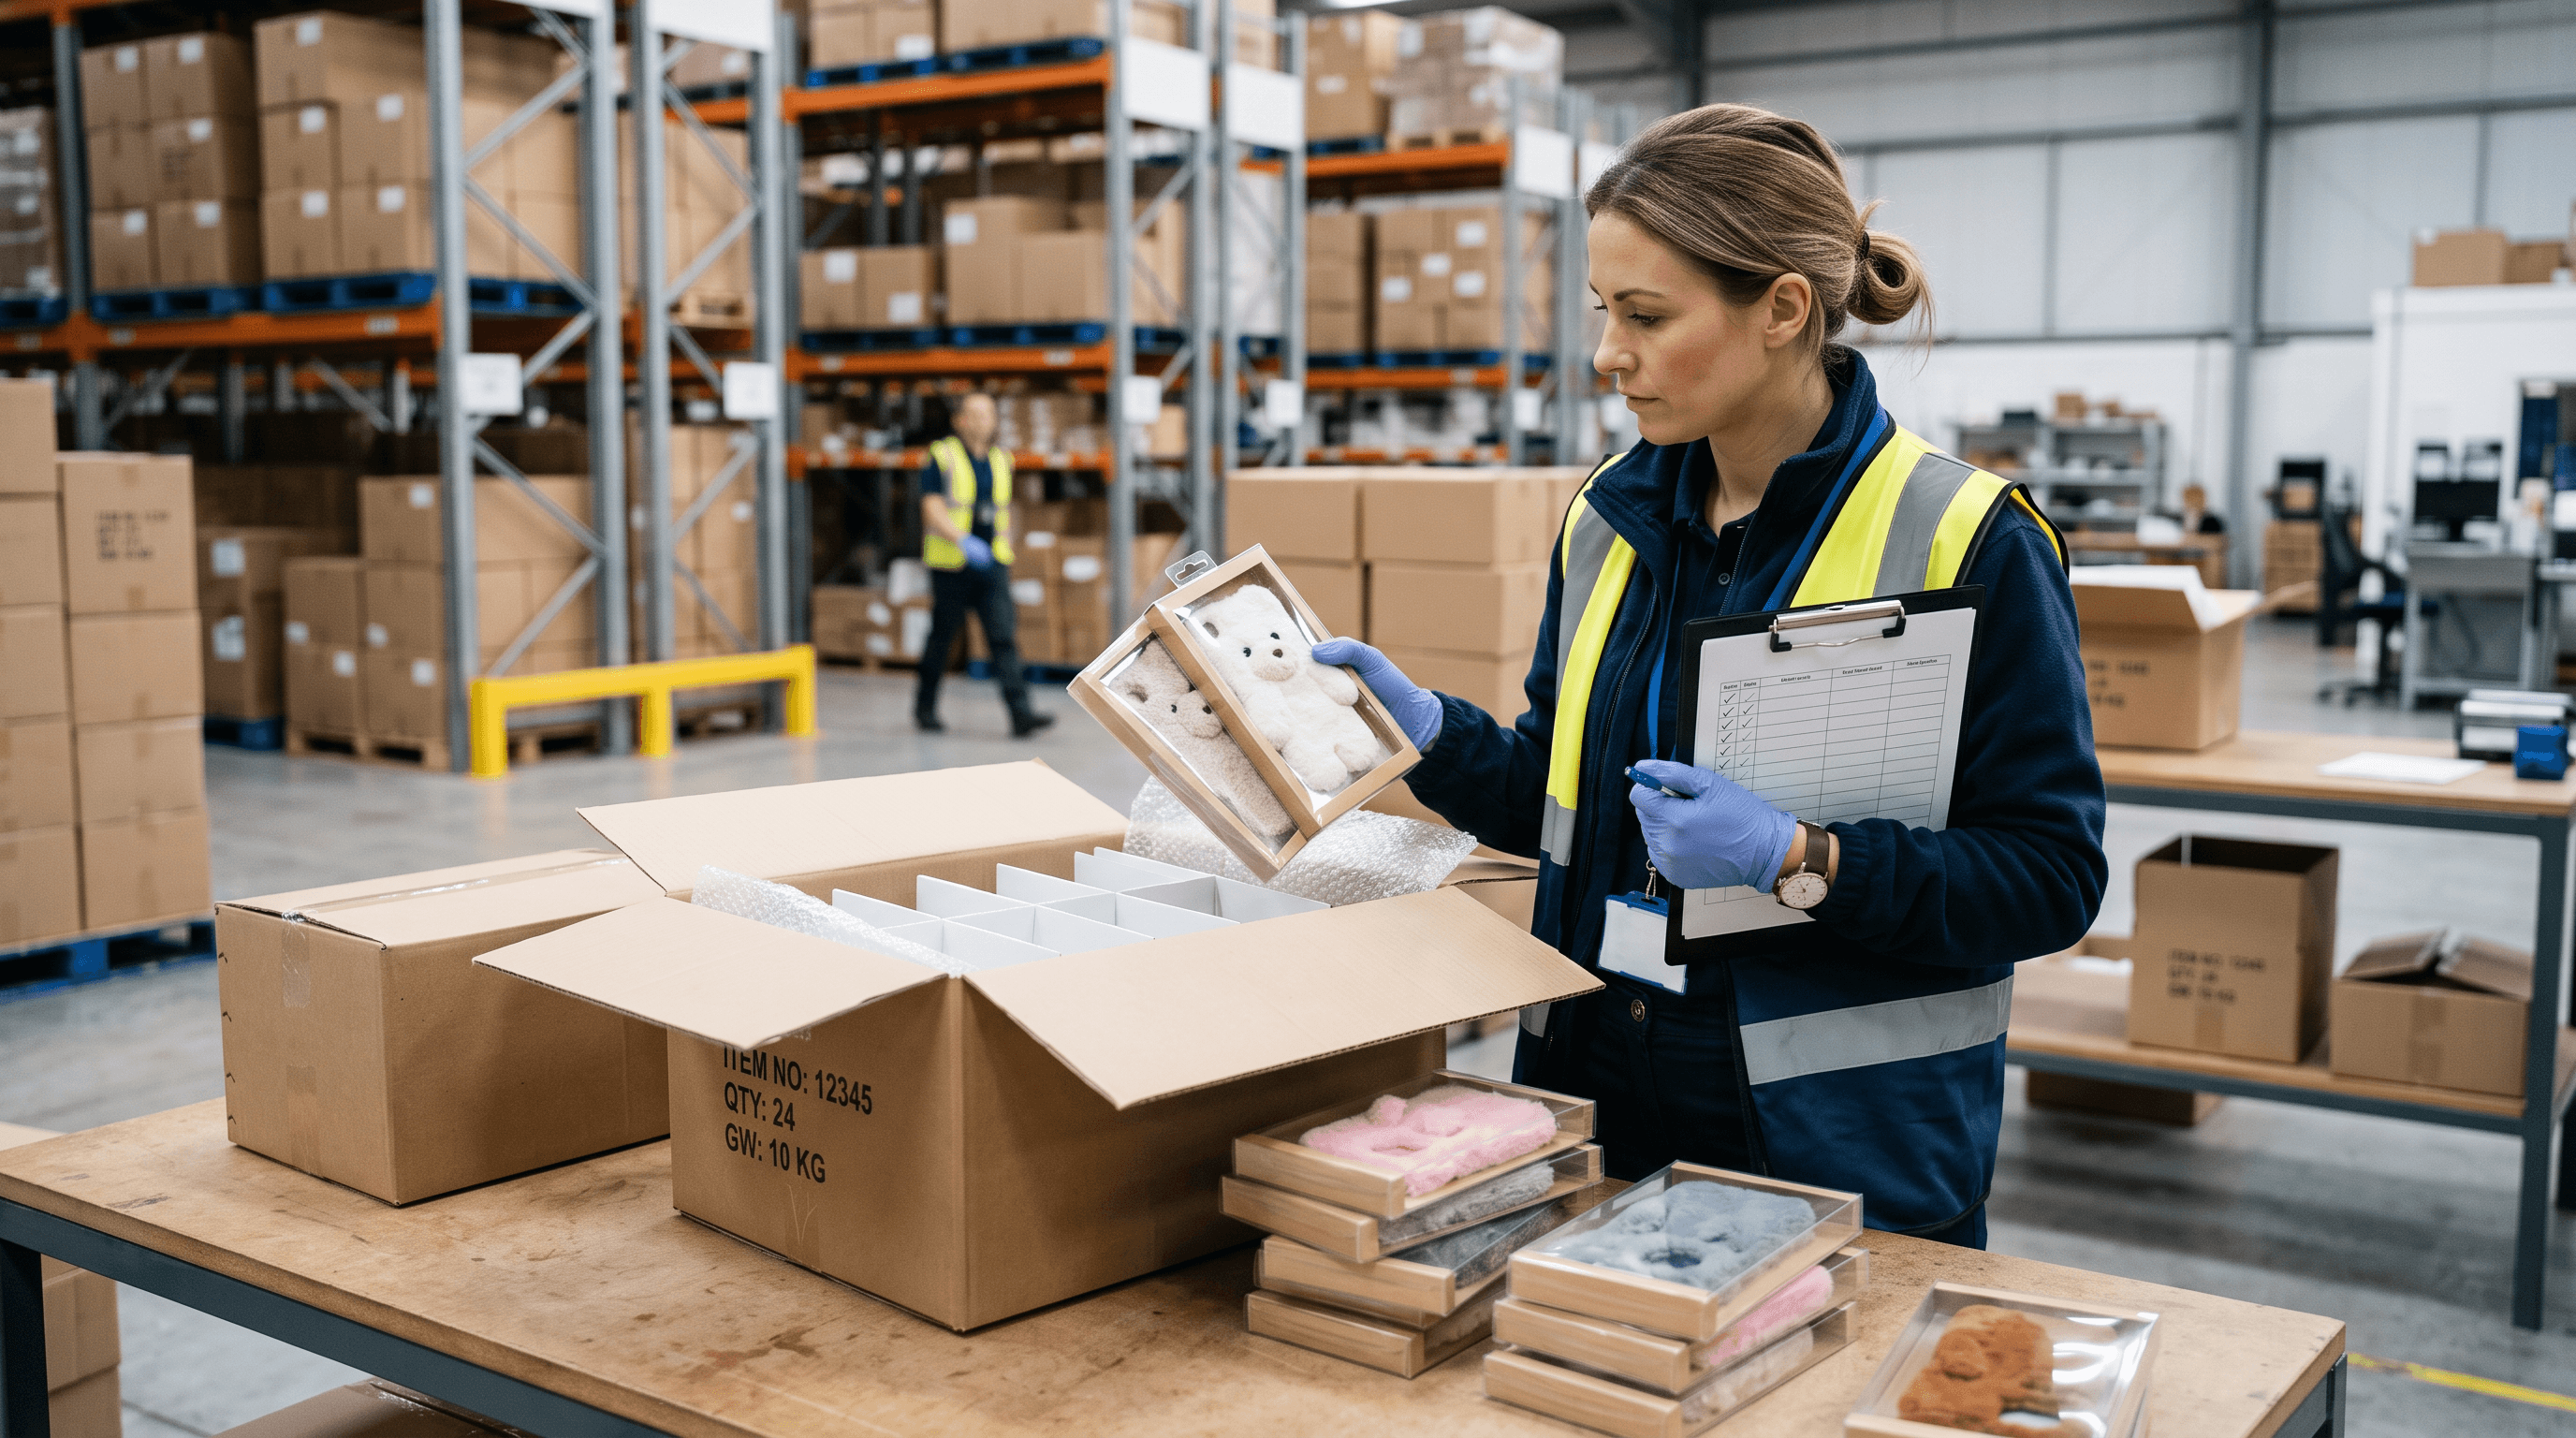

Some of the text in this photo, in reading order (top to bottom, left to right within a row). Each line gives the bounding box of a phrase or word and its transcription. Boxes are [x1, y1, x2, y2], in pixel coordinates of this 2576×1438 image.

[724, 1081, 796, 1132] QTY: 24
[773, 1055, 808, 1093] NO:
[815, 1069, 872, 1115] 12345
[724, 1123, 826, 1183] GW: 10 KG
